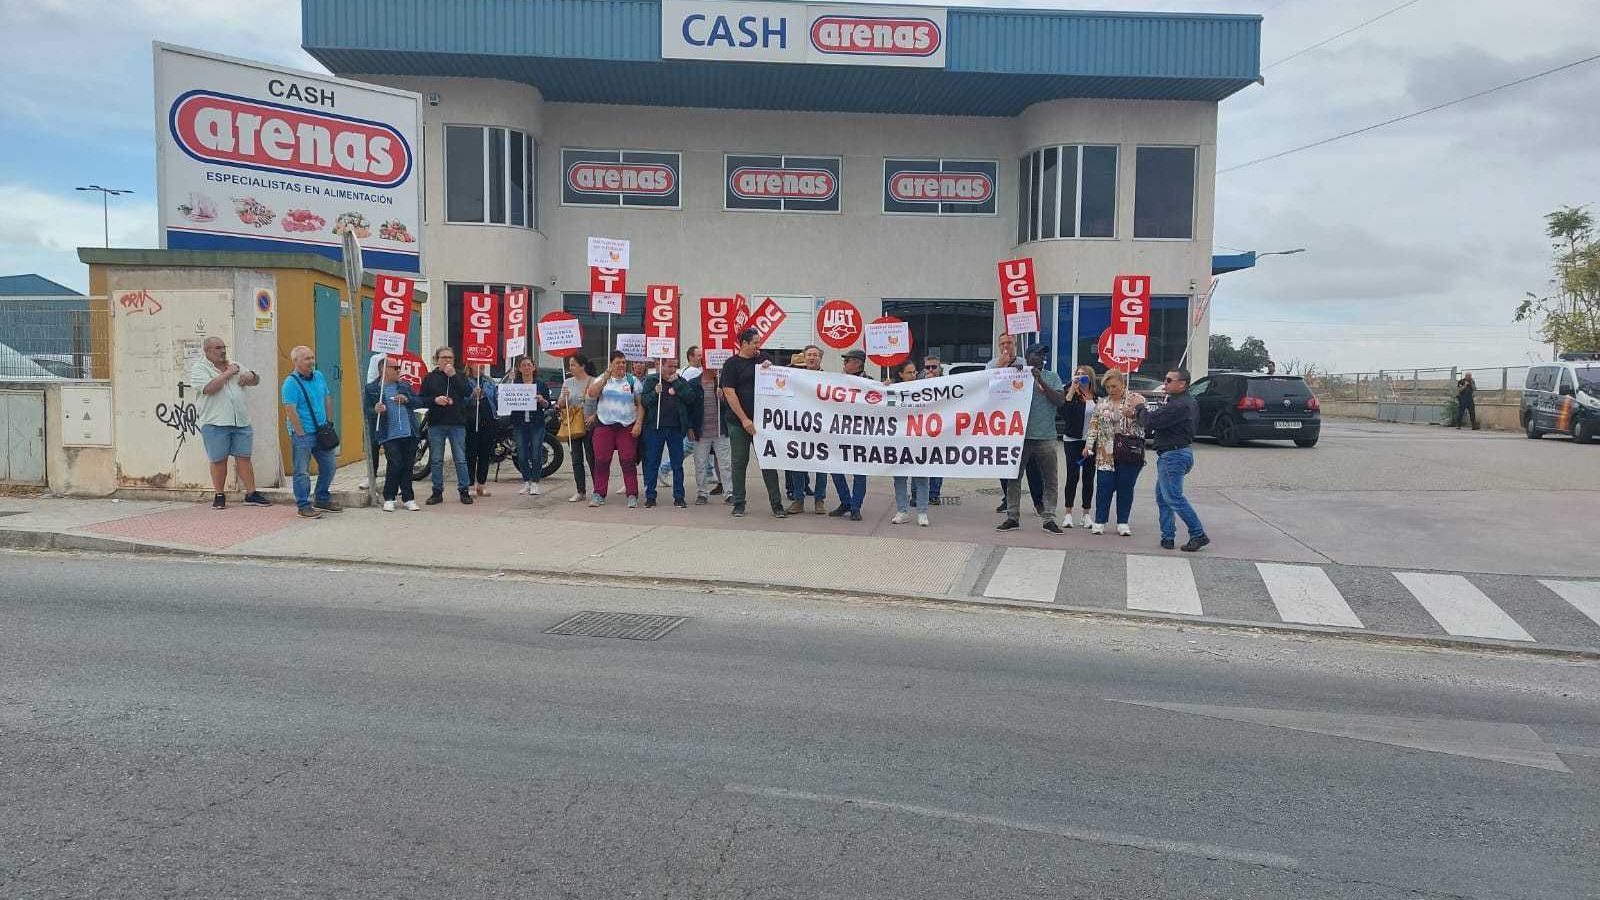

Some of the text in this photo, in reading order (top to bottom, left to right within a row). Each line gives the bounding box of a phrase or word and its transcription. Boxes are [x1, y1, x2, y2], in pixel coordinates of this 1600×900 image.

[682, 14, 931, 50] CASH arenas
[268, 79, 335, 108] CASH
[194, 106, 394, 176] arenas
[206, 171, 393, 205] ESPECIALISTAS EN ALIMENTACIÓN
[576, 166, 667, 190] arenas
[740, 170, 828, 196] arenas
[897, 174, 987, 199] arenas
[381, 279, 407, 332] UGT
[1005, 262, 1030, 314] UGT
[470, 296, 492, 345] UGT
[509, 293, 525, 339] UGT
[652, 288, 673, 337] UGT
[823, 308, 856, 327] UGT
[1119, 279, 1144, 335] UGT
[707, 301, 729, 351] UGT
[816, 383, 965, 404] UGT FeSMC
[762, 408, 1025, 438] POLLOS ARENAS NO PAGA
[763, 440, 1021, 466] A SUS TRABAJADORES
